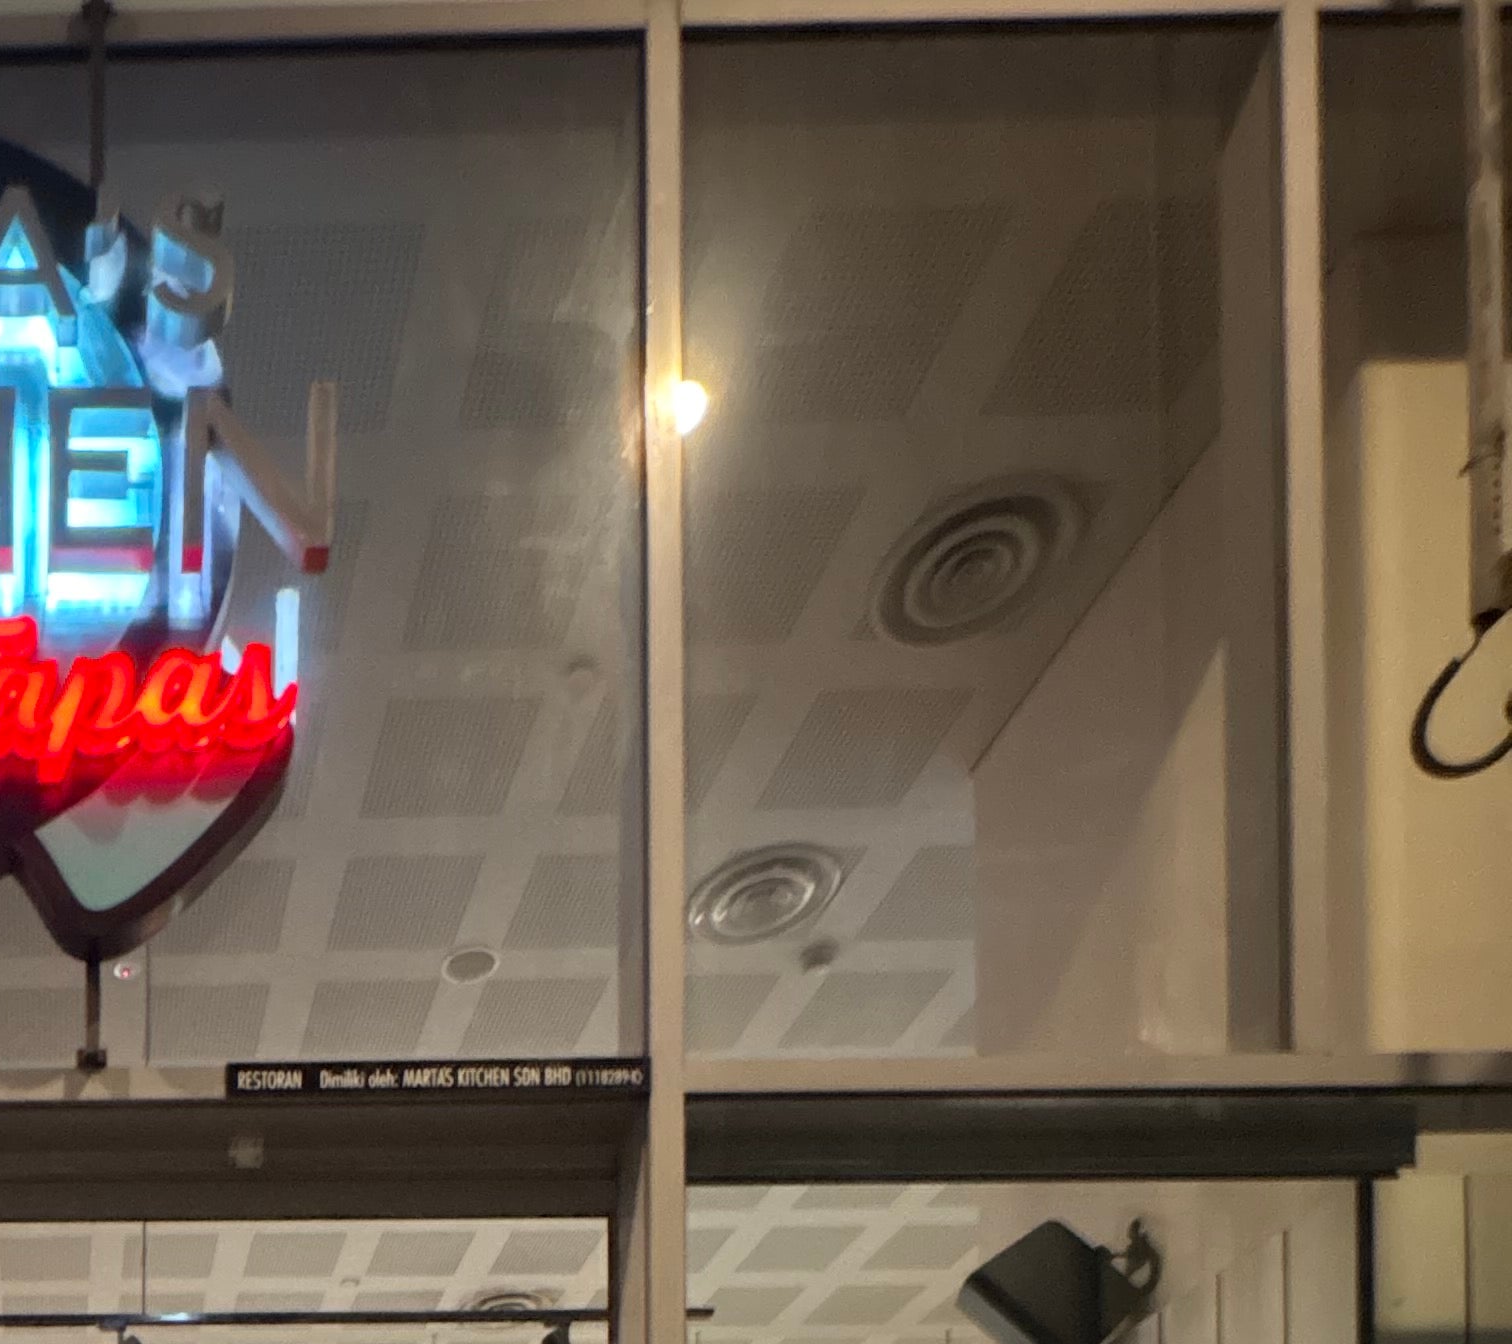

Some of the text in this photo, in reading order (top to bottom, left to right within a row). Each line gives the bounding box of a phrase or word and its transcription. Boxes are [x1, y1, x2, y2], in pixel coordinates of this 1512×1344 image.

[237, 1069, 303, 1090] RESTORAN
[319, 1068, 365, 1089] Dimiliki
[457, 1067, 510, 1088] KITCHEN
[544, 1066, 572, 1087] BHD
